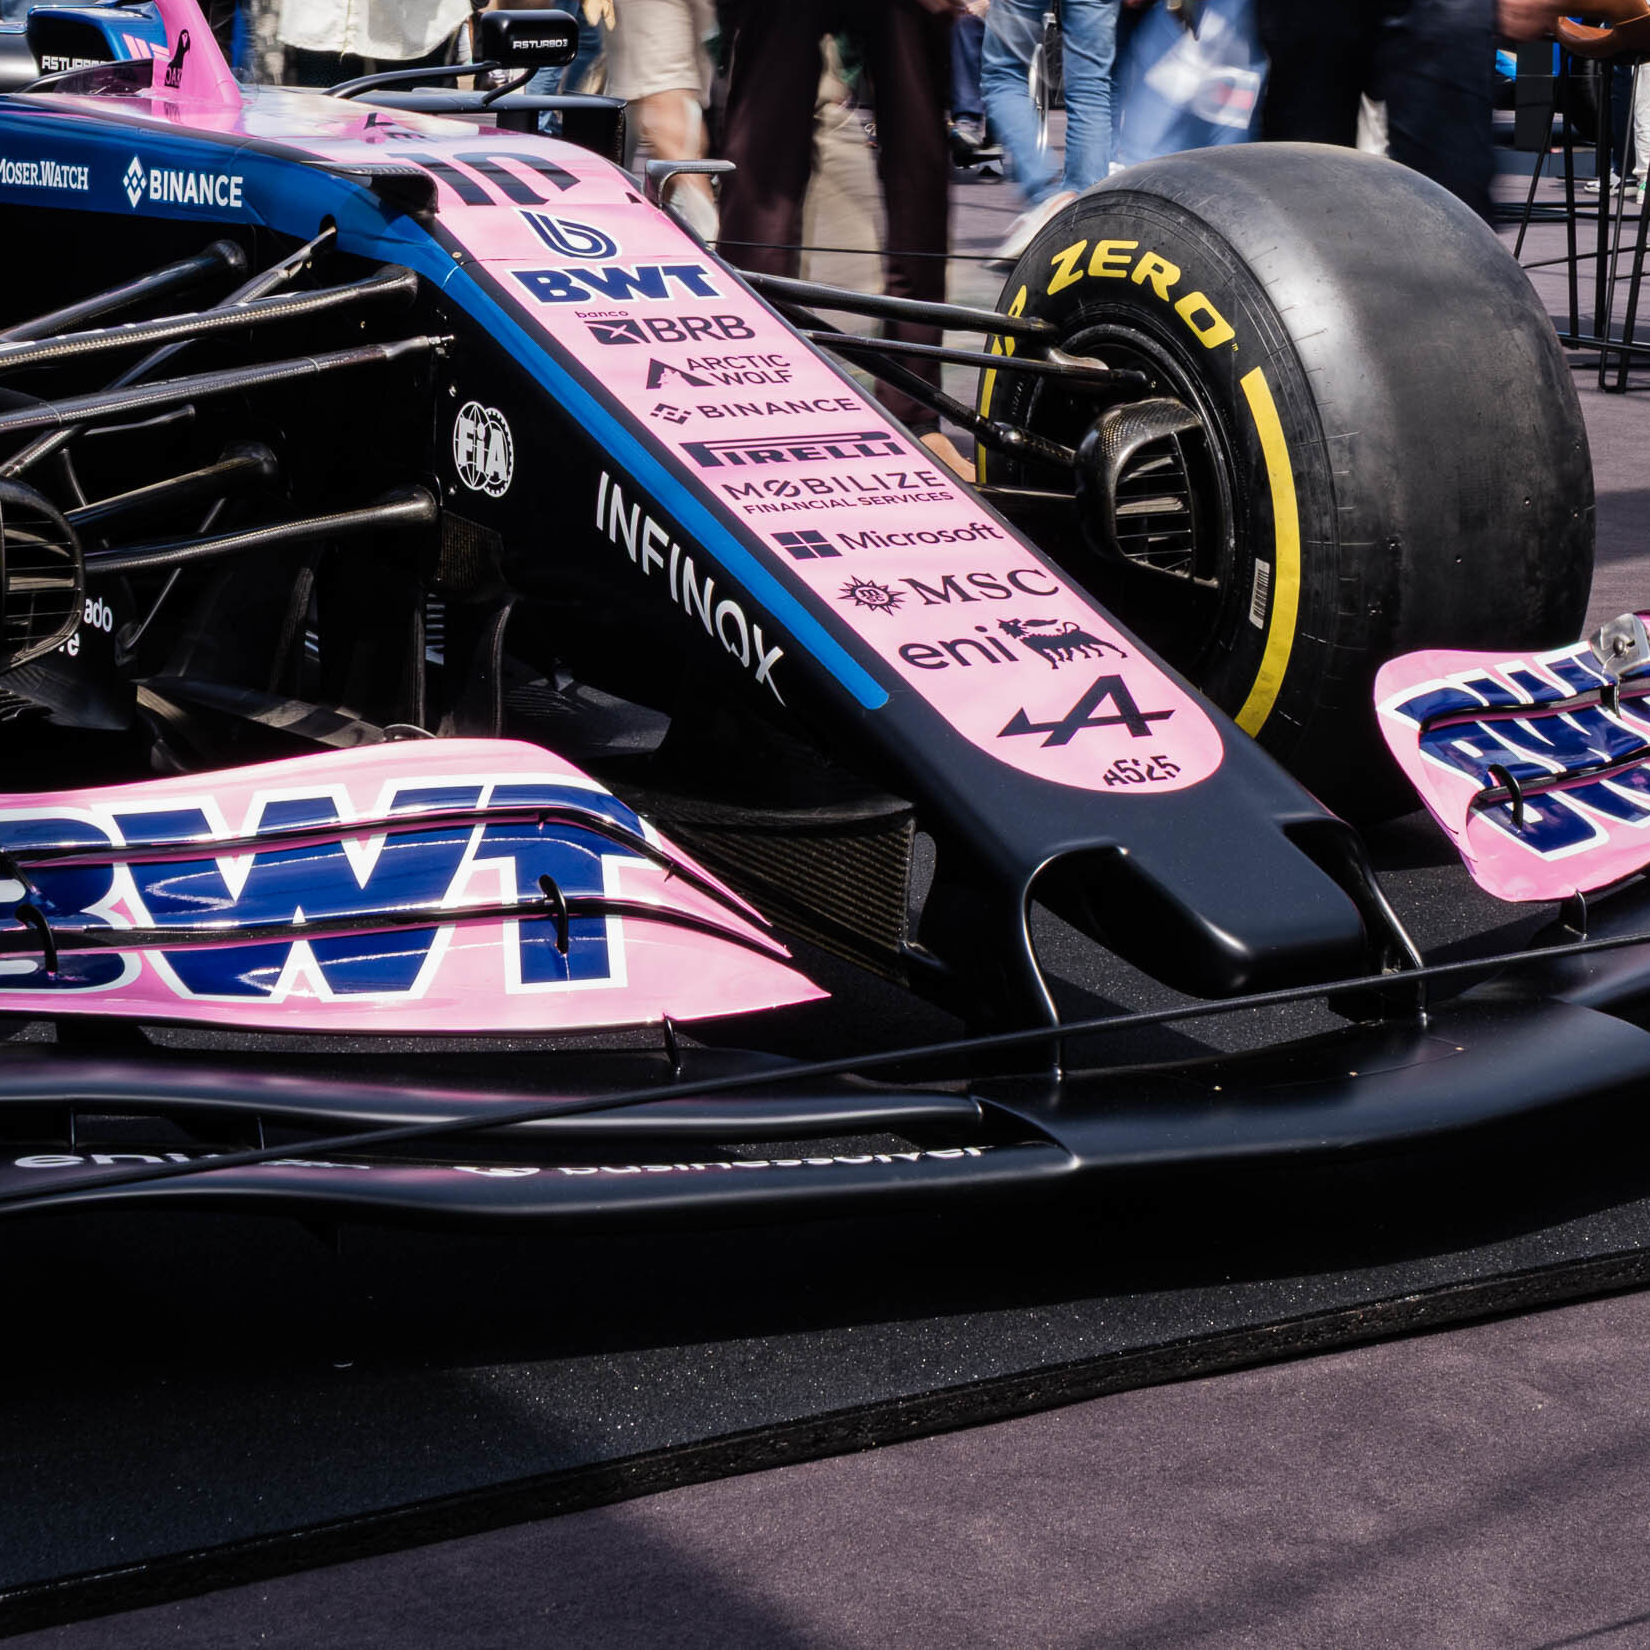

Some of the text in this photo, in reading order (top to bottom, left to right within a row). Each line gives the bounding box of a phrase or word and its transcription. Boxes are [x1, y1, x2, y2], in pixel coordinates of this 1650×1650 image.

[149, 169, 244, 209] BINANCE
[384, 152, 581, 207] 10
[506, 263, 725, 305] BWT
[1046, 238, 1236, 349] ZERO
[575, 310, 629, 319] banco
[643, 315, 756, 343] BRB
[687, 353, 791, 372] ARCTIC
[710, 369, 794, 386] WOLF
[696, 397, 862, 419] BINANCE
[678, 430, 907, 468] PIRELLI
[742, 490, 955, 515] FINANCIAL SERVICES
[836, 521, 1005, 550] Microsoft
[596, 470, 787, 708] INFINOX
[898, 568, 1060, 607] MSC
[897, 625, 1020, 670] eni
